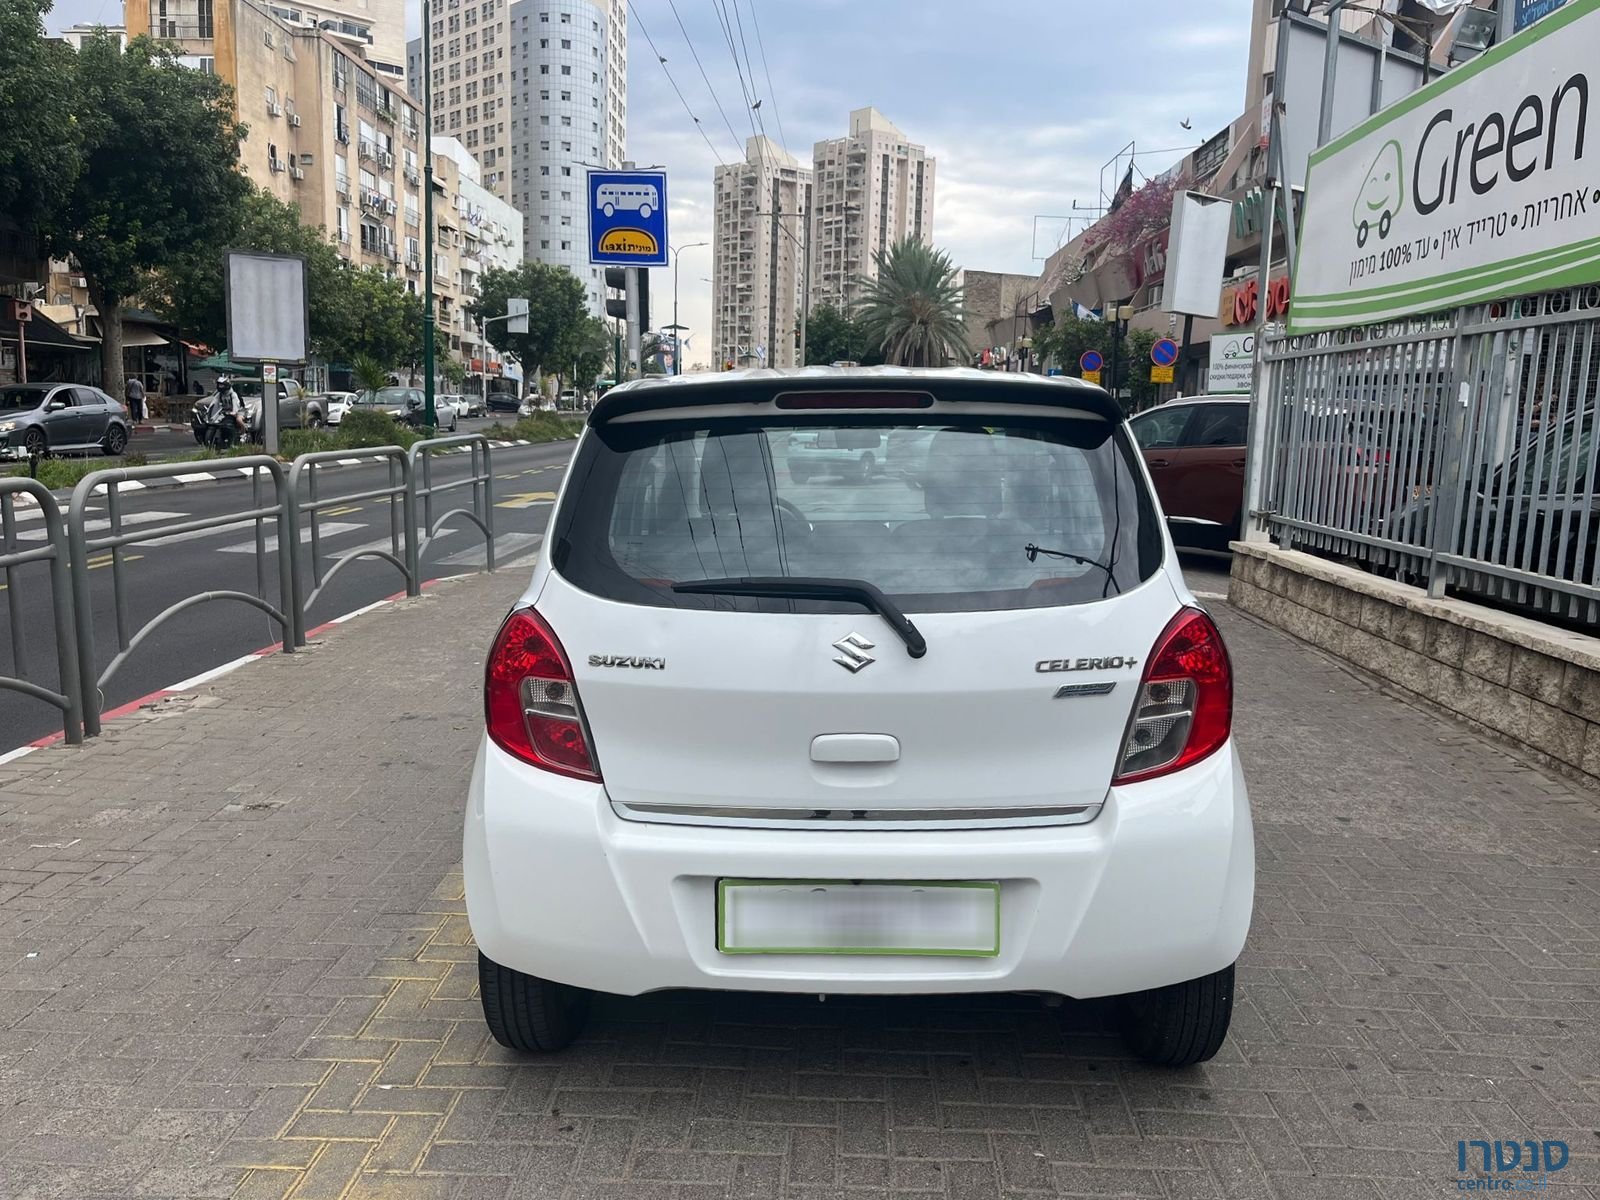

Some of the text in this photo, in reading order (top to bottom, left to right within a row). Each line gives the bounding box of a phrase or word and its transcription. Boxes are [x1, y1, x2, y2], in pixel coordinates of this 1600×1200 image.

[1413, 73, 1589, 216] Green
[605, 237, 627, 252] taxi
[1349, 186, 1589, 286] אחריות טרייד אין עד 100% מימון
[627, 243, 652, 252] מונית
[588, 654, 666, 671] SUZUKI
[1035, 656, 1138, 673] CELERIO+
